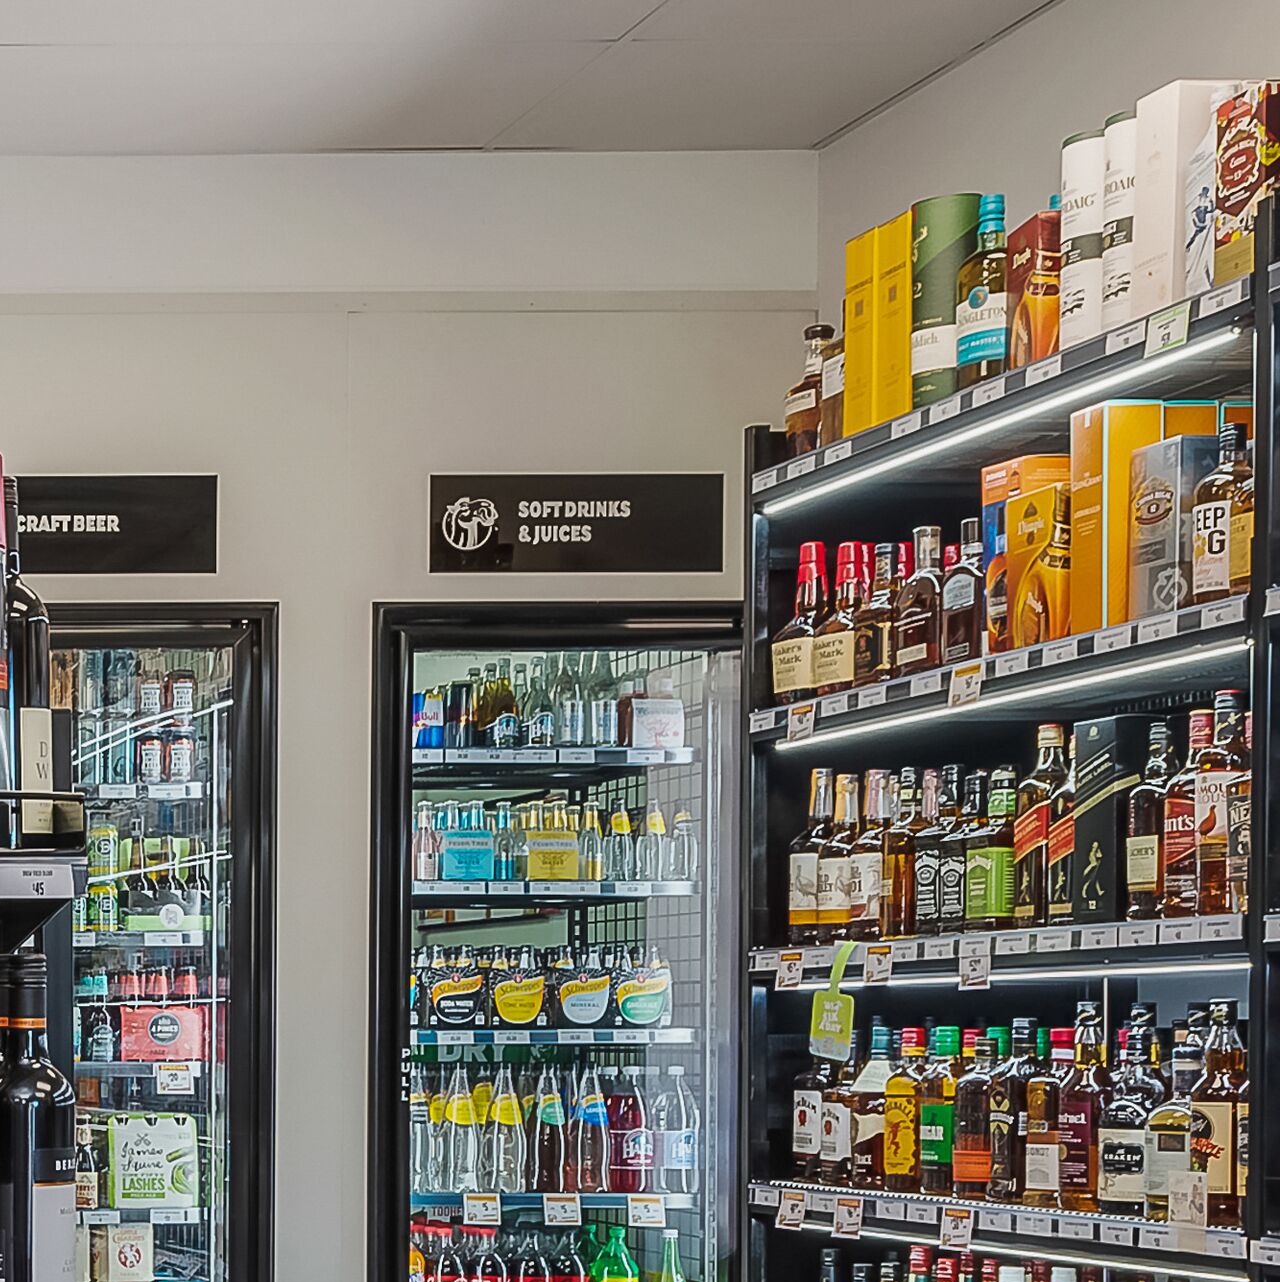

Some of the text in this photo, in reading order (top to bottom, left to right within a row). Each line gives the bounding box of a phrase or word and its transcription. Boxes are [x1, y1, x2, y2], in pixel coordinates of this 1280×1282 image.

[518, 500, 631, 519] SOFT DRINKS
[17, 516, 120, 532] CRAFT BEER
[518, 526, 592, 544] & JUICES
[1104, 1153, 1141, 1162] KRAKEN
[122, 1178, 165, 1191] LASHES
